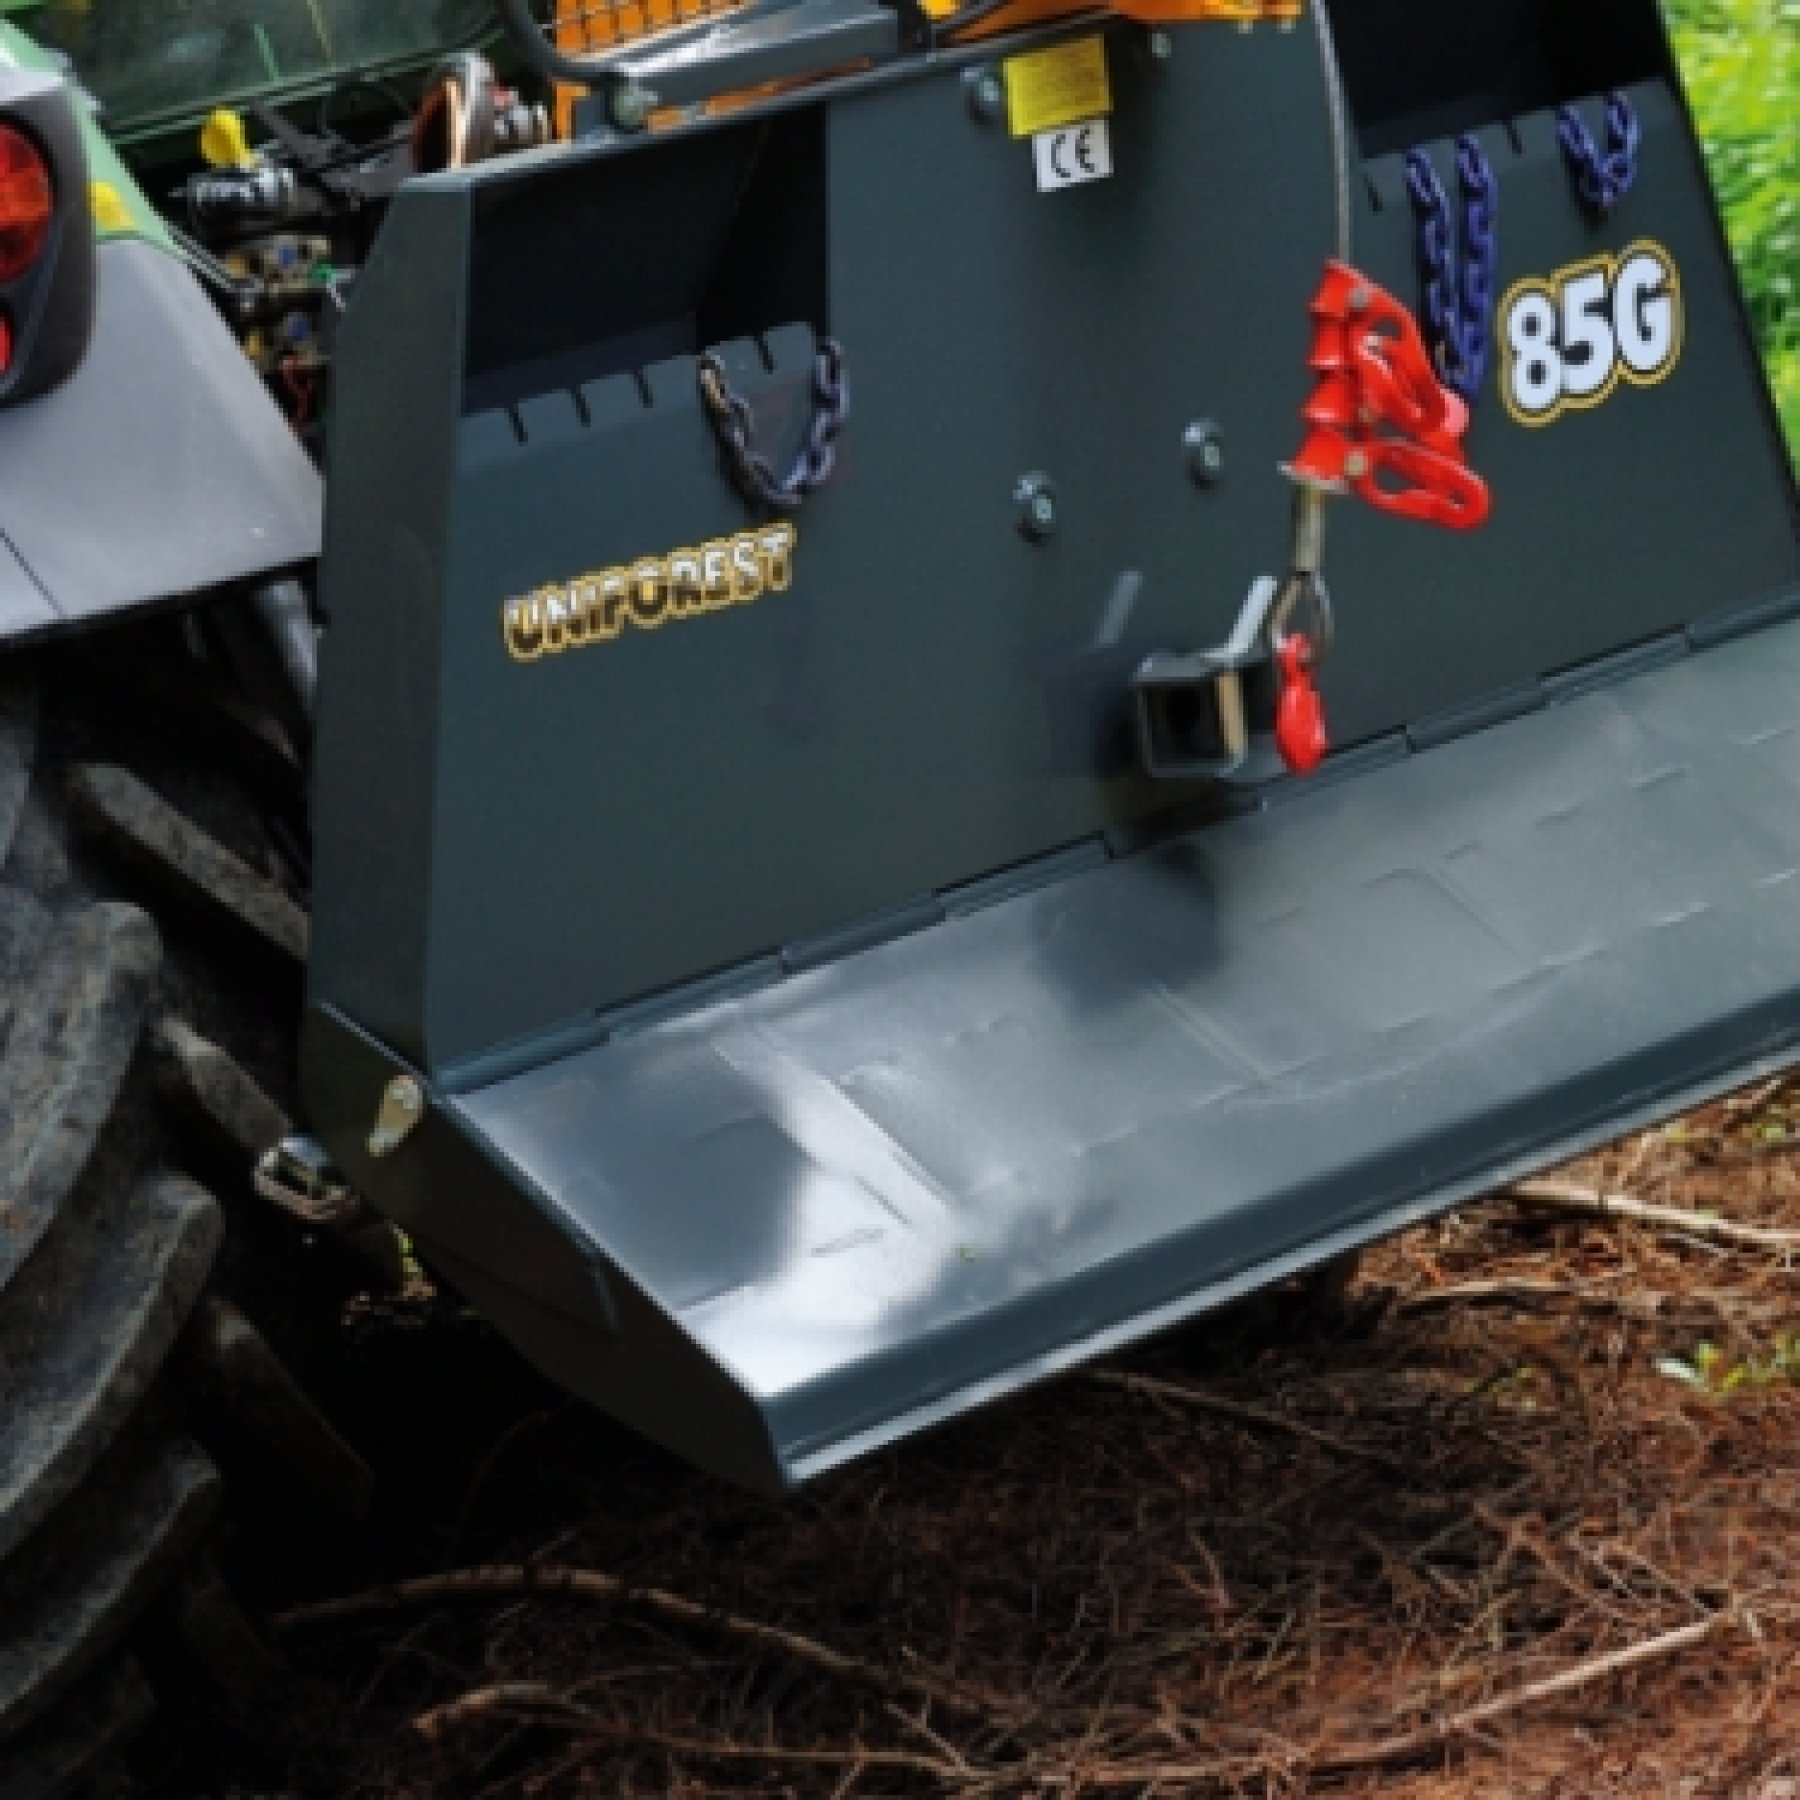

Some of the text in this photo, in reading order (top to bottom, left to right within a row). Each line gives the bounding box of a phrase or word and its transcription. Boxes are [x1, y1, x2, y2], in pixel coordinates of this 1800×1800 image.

[1050, 128, 1097, 178] CE
[1499, 239, 1681, 426] 85G
[503, 524, 796, 661] UNIFOREST
